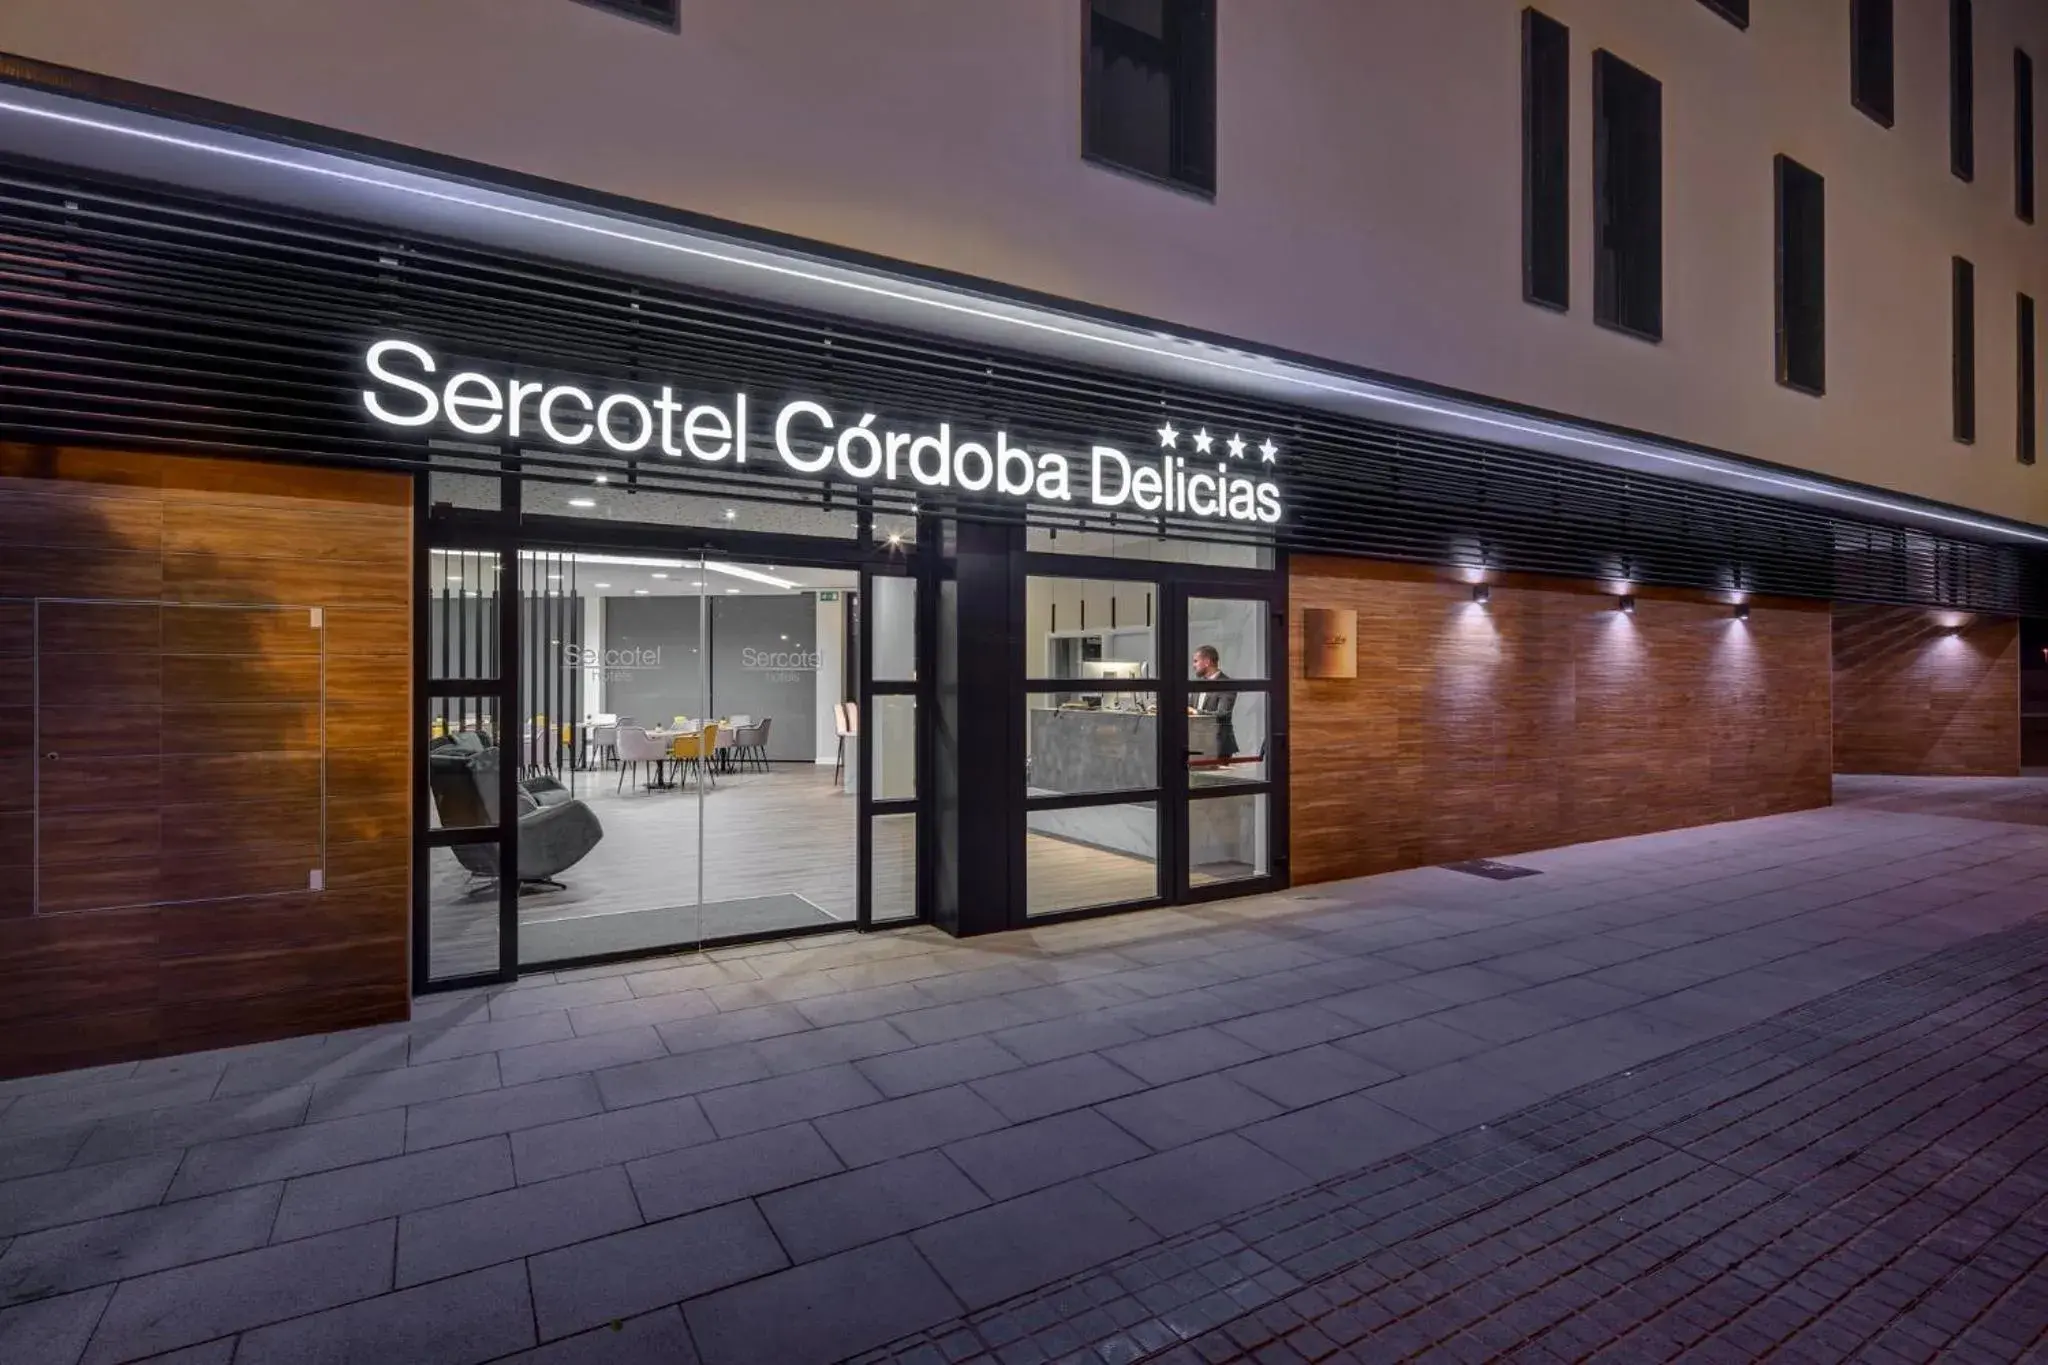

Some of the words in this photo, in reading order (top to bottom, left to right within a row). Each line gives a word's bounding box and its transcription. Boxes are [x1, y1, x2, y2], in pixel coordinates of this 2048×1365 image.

[362, 339, 747, 464] Sercotel
[774, 399, 1073, 502] Córdoba
[1090, 444, 1283, 524] Delicias
[563, 643, 661, 667] Secotel
